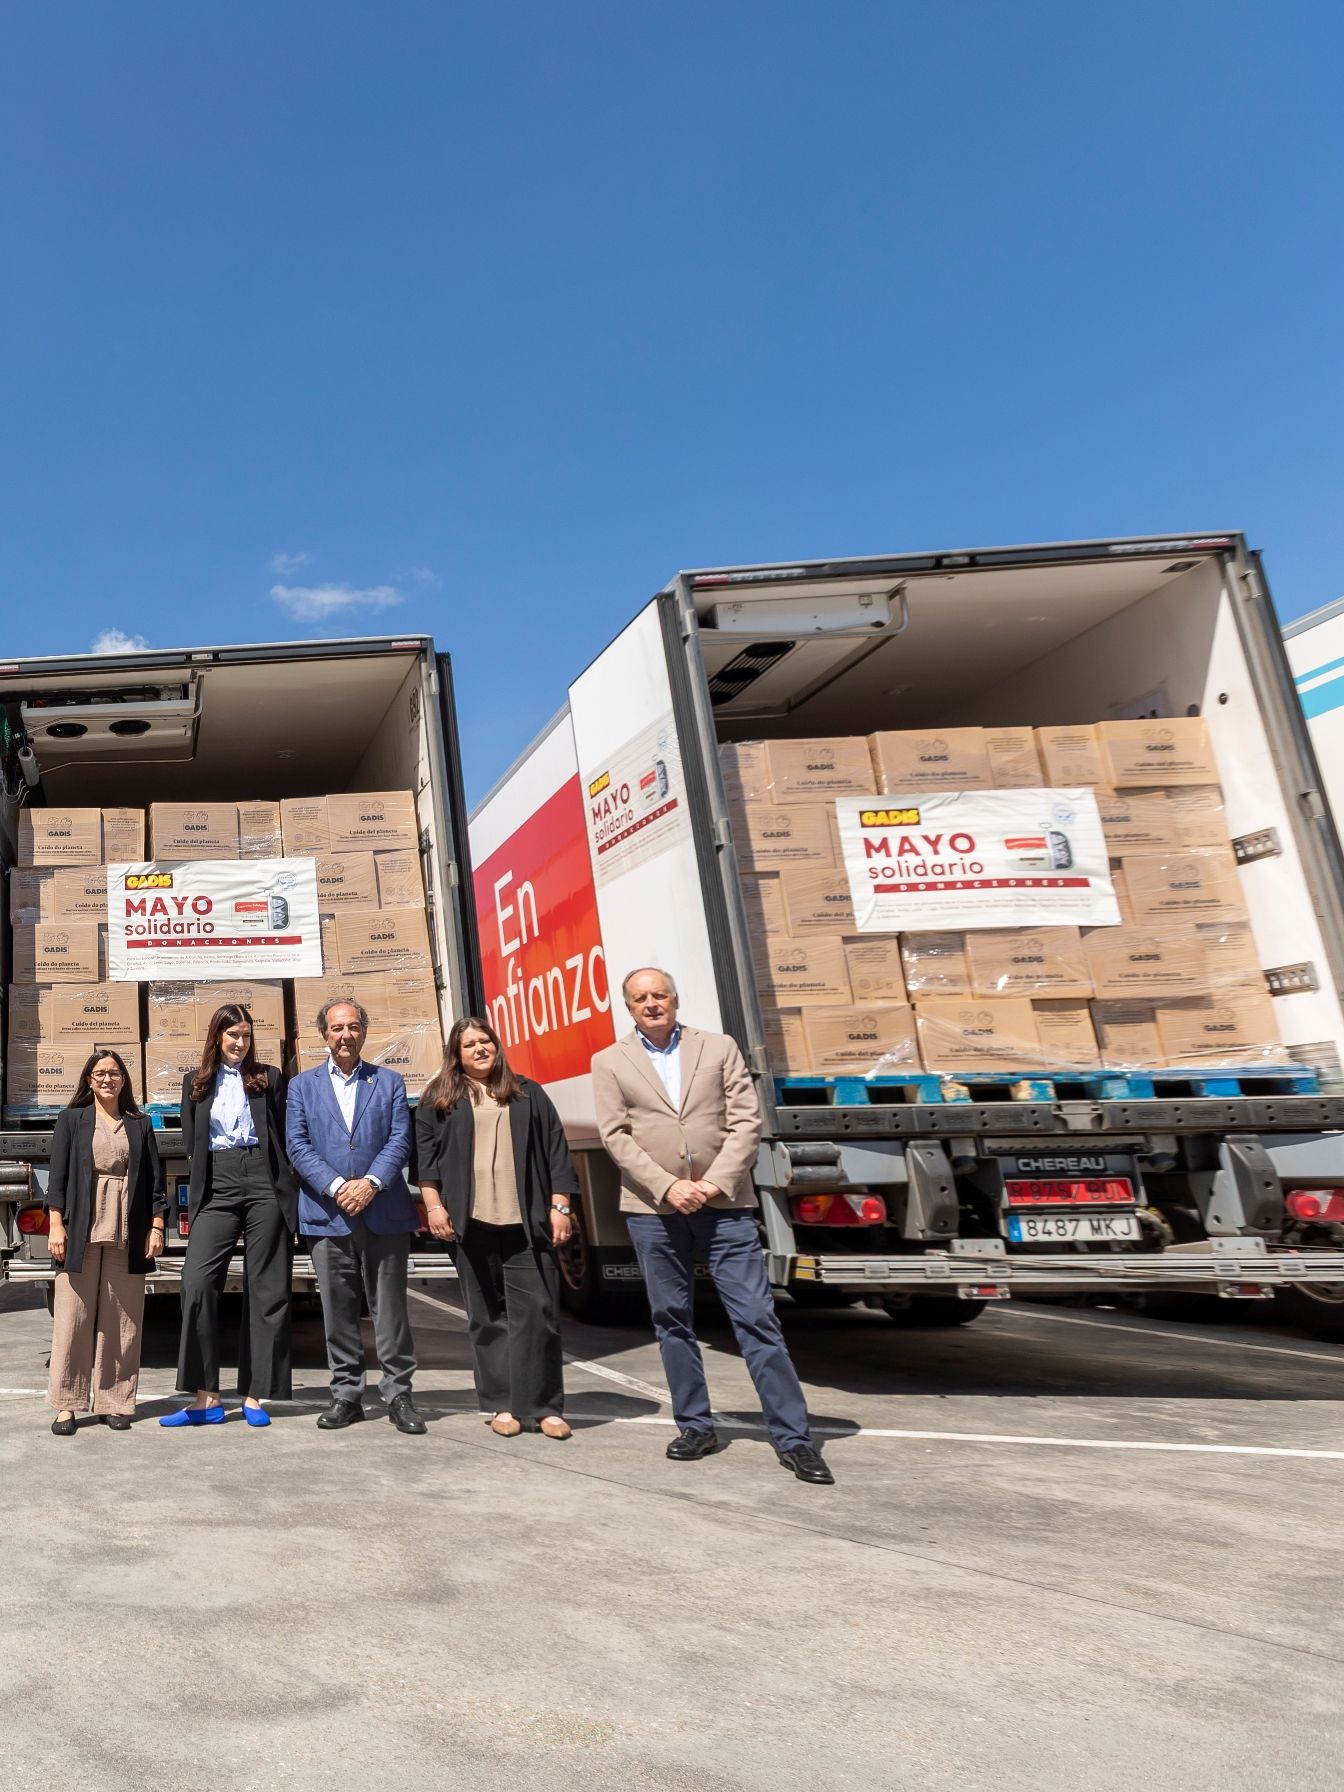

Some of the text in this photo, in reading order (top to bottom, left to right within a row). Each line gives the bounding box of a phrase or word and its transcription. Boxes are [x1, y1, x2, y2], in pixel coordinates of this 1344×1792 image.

[591, 783, 631, 825] MAYO
[594, 808, 634, 843] solidario
[606, 805, 668, 848] DONACIONES
[861, 809, 919, 826] GADIS
[863, 832, 976, 859] MAYO
[868, 857, 984, 879] solidario
[126, 874, 172, 889] GADIS
[320, 876, 344, 884] GADIS
[899, 879, 1065, 891] DONACIONES
[125, 895, 213, 917] MAYO
[494, 869, 540, 958] En
[125, 917, 215, 936] solidario
[370, 932, 395, 940] GADIS
[147, 938, 280, 946] DONACIONES
[384, 1057, 410, 1065] GADIS
[1017, 1157, 1105, 1171] CHEREAU
[1026, 1218, 1133, 1237] 8487 MKJ
